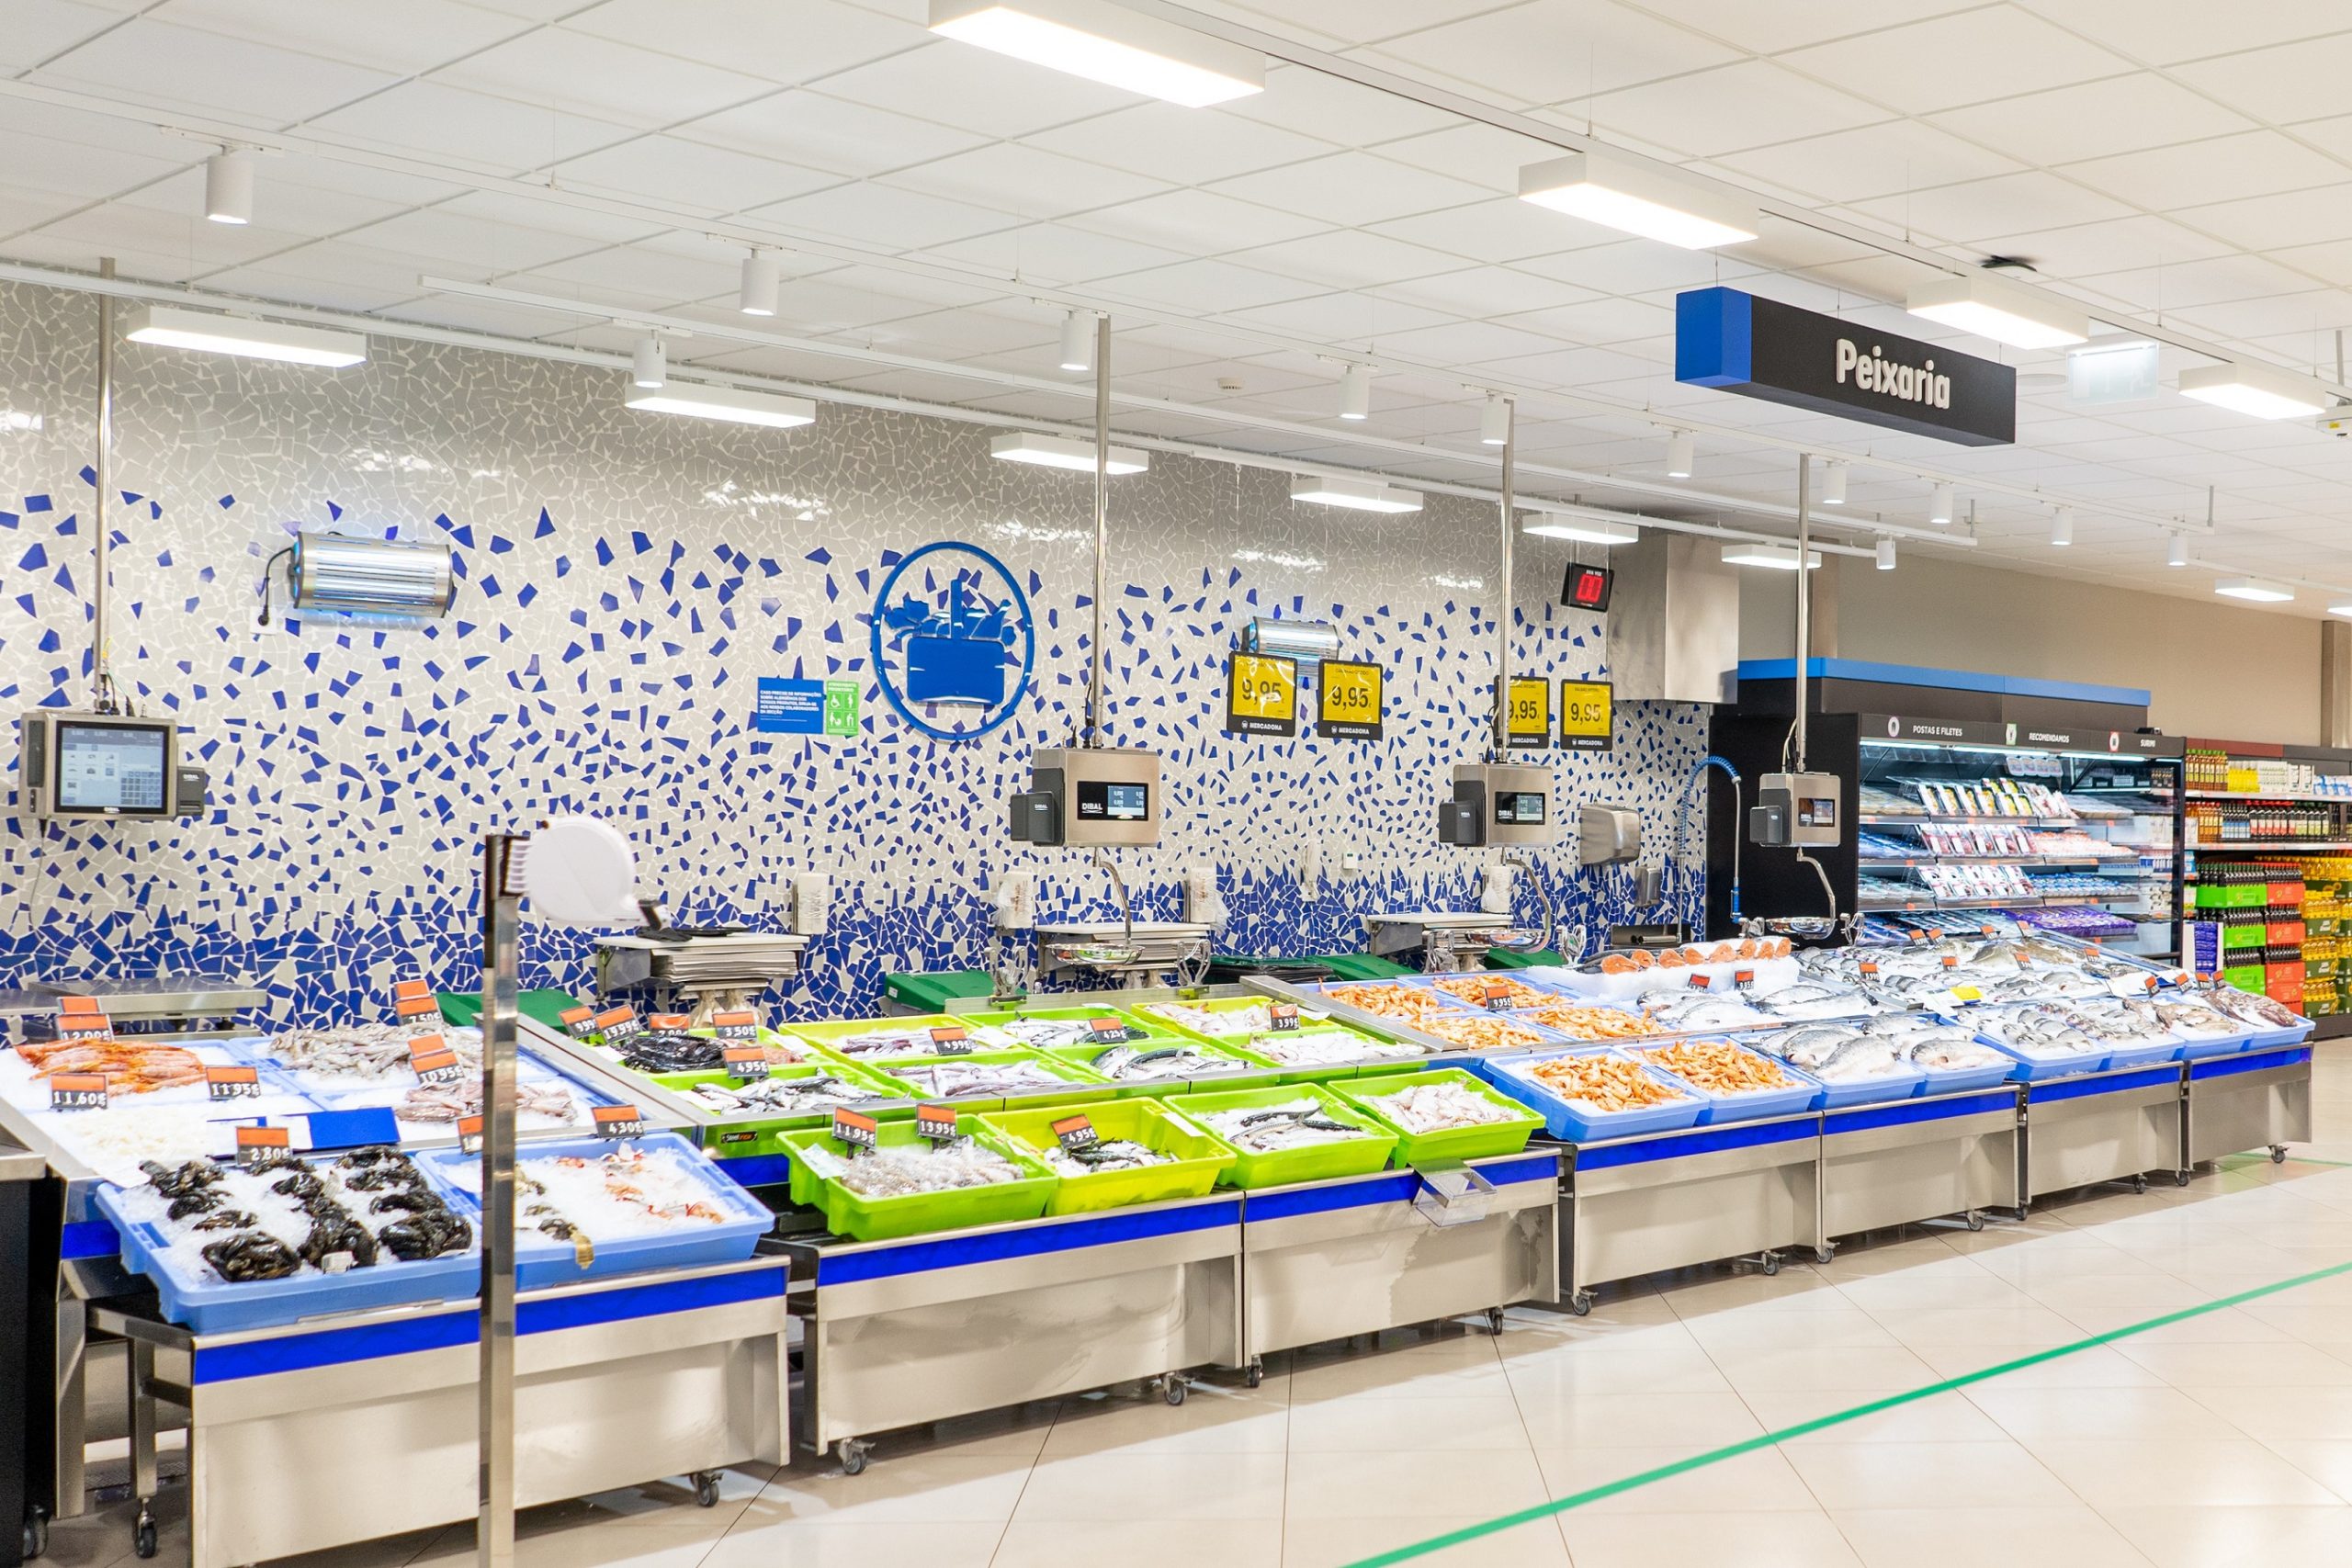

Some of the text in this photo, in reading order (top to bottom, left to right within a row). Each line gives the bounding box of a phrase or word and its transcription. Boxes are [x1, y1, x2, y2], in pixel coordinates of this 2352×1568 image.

[1837, 338, 1950, 409] Peixaria
[1250, 723, 1283, 731] MERCADONA
[1913, 725, 1962, 737] POSTAS E FILETES
[2029, 733, 2069, 743] RECOMENDAMOS
[1082, 802, 1102, 810] DIBAL
